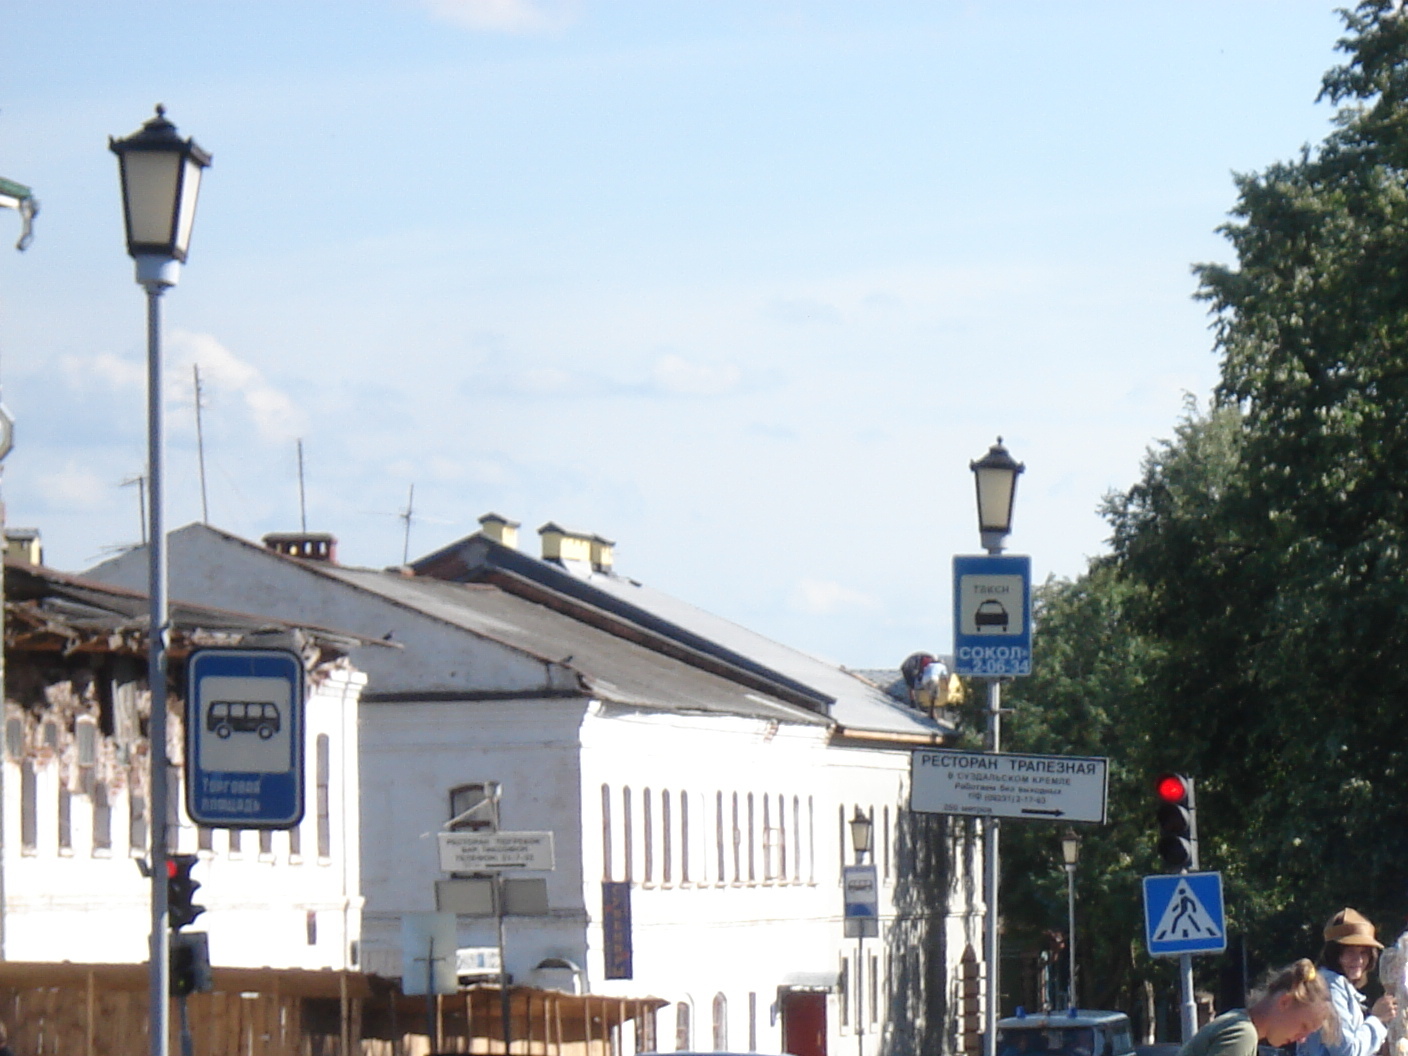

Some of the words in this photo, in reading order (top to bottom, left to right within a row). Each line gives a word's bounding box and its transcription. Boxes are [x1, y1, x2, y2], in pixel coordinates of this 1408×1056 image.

[921, 754, 998, 770] РЕСТОРАН
[1009, 759, 1096, 775] ТРАПЕЗНАЯ
[957, 773, 1029, 784] СУЗДАЛЬСКОМ
[1032, 777, 1071, 786] КРЕМЛЕ
